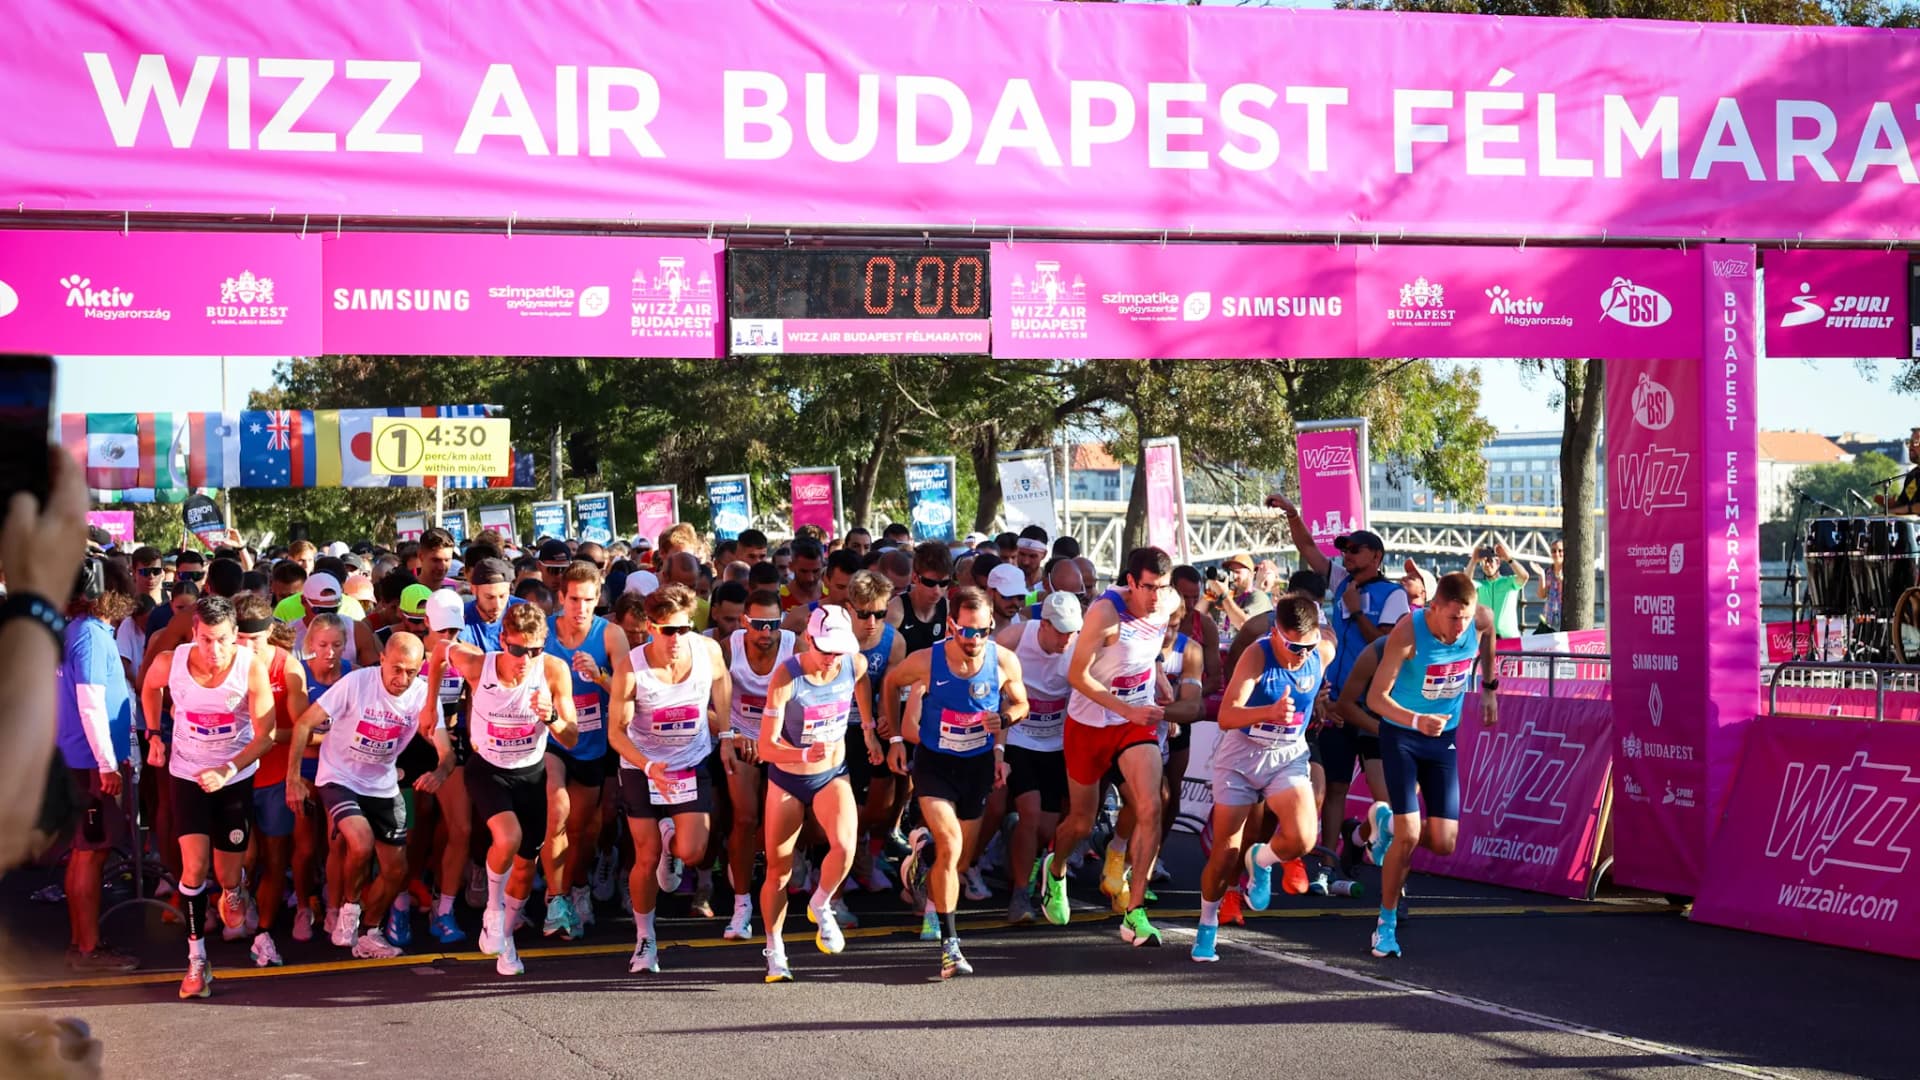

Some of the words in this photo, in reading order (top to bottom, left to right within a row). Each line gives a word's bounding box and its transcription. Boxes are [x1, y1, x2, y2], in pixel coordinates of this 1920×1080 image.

[83, 52, 424, 153] WIZZ
[454, 63, 667, 159] AIR
[722, 69, 1348, 173] BUDAPEST
[1394, 67, 1920, 183] FÉLMARA
[488, 285, 575, 300] szimpatika
[864, 256, 983, 315] 0:00
[333, 287, 470, 311] SAMSUNG
[506, 298, 575, 310] gyógyszertár
[1102, 291, 1180, 306] szimpatika
[1830, 296, 1891, 312] SPURI
[84, 307, 171, 321] Magyarország
[206, 306, 289, 318] BUDAPEST
[631, 302, 677, 317] WIZZ
[684, 303, 712, 317] AIR
[1011, 306, 1054, 318] WIZZ
[1061, 306, 1087, 318] AIR
[1118, 304, 1179, 316] gyógyszertár
[1222, 296, 1343, 318] SAMSUNG
[1387, 308, 1456, 320] BUDAPEST
[1629, 294, 1659, 323] BSI
[631, 316, 712, 330] BUDAPEST
[1011, 318, 1087, 331] BUDAPEST
[1505, 315, 1573, 328] Magyarország
[1825, 313, 1895, 328] FUTÓBOLT
[631, 329, 713, 339] FÉLMARATON
[787, 332, 818, 344] WIZZ
[823, 332, 841, 344] AIR
[844, 332, 903, 344] BUDAPEST
[905, 330, 983, 344] FÉLMARATON
[1011, 330, 1088, 340] FÉLMARATON
[1724, 291, 1739, 431] BUDAPEST
[1647, 391, 1667, 425] BSI
[426, 425, 487, 447] 4:30
[391, 428, 407, 468] 1
[424, 452, 467, 463] perc/km
[469, 452, 492, 461] alatt
[424, 463, 455, 472] within
[458, 463, 496, 474] min/km
[1006, 490, 1049, 501] BUDAPEST
[1725, 451, 1741, 626] FÉLMARATON
[1627, 543, 1667, 558] szimpatika
[1634, 595, 1675, 615] POWER
[1651, 615, 1676, 635] ADE
[1632, 654, 1679, 671] SAMSUNG
[1643, 742, 1695, 760] BUDAPEST
[1471, 832, 1558, 865] wizzair.com
[1777, 881, 1898, 922] wizzair.com
